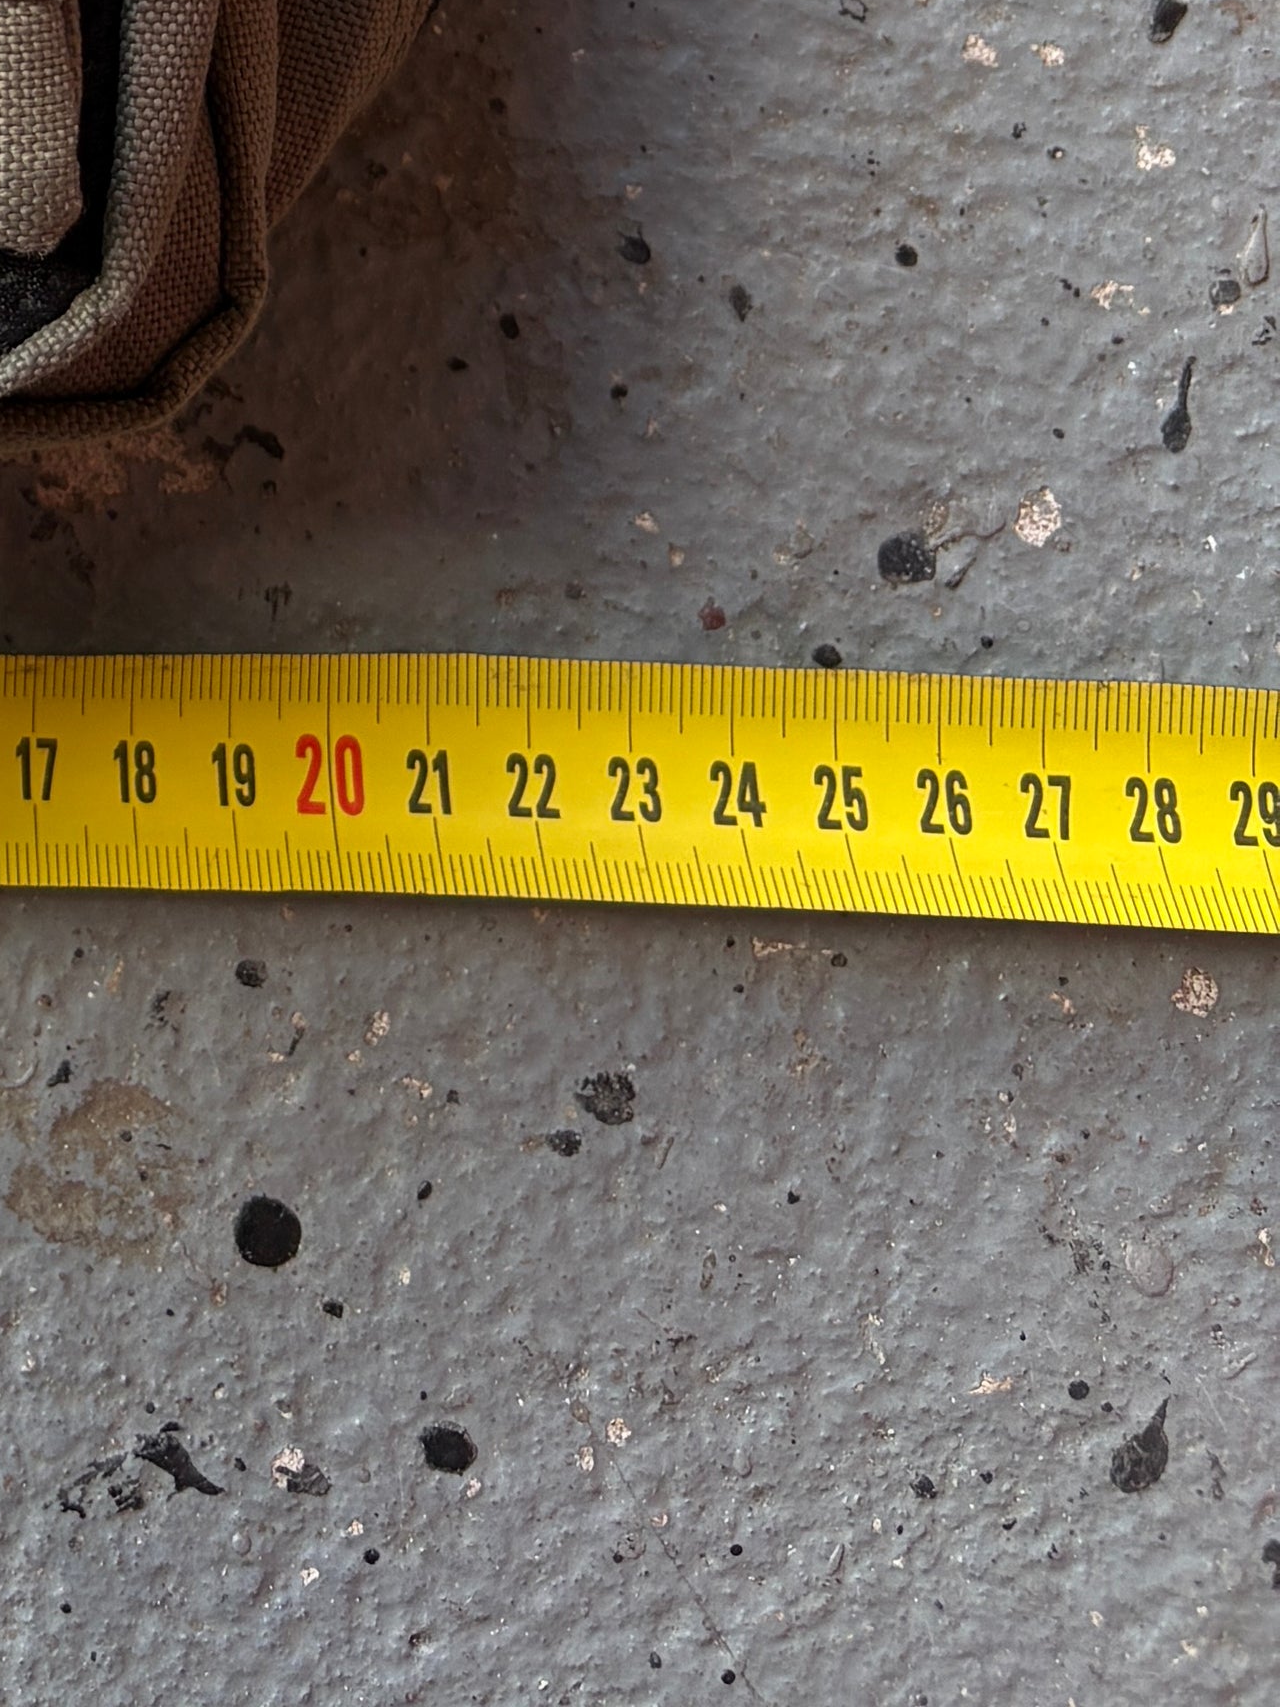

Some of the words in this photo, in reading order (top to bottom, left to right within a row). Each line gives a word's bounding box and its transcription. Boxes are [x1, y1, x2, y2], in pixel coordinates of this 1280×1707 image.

[15, 736, 59, 802] 17
[113, 739, 157, 804] 18
[211, 742, 256, 807] 19
[294, 733, 366, 818] 20
[406, 749, 452, 815] 21
[506, 753, 561, 819] 22
[608, 757, 662, 823] 23
[710, 761, 767, 828] 24
[814, 765, 868, 831] 25
[917, 768, 972, 835] 26
[1020, 773, 1071, 841] 27
[1125, 777, 1182, 844] 28
[1230, 781, 1280, 847] 29
